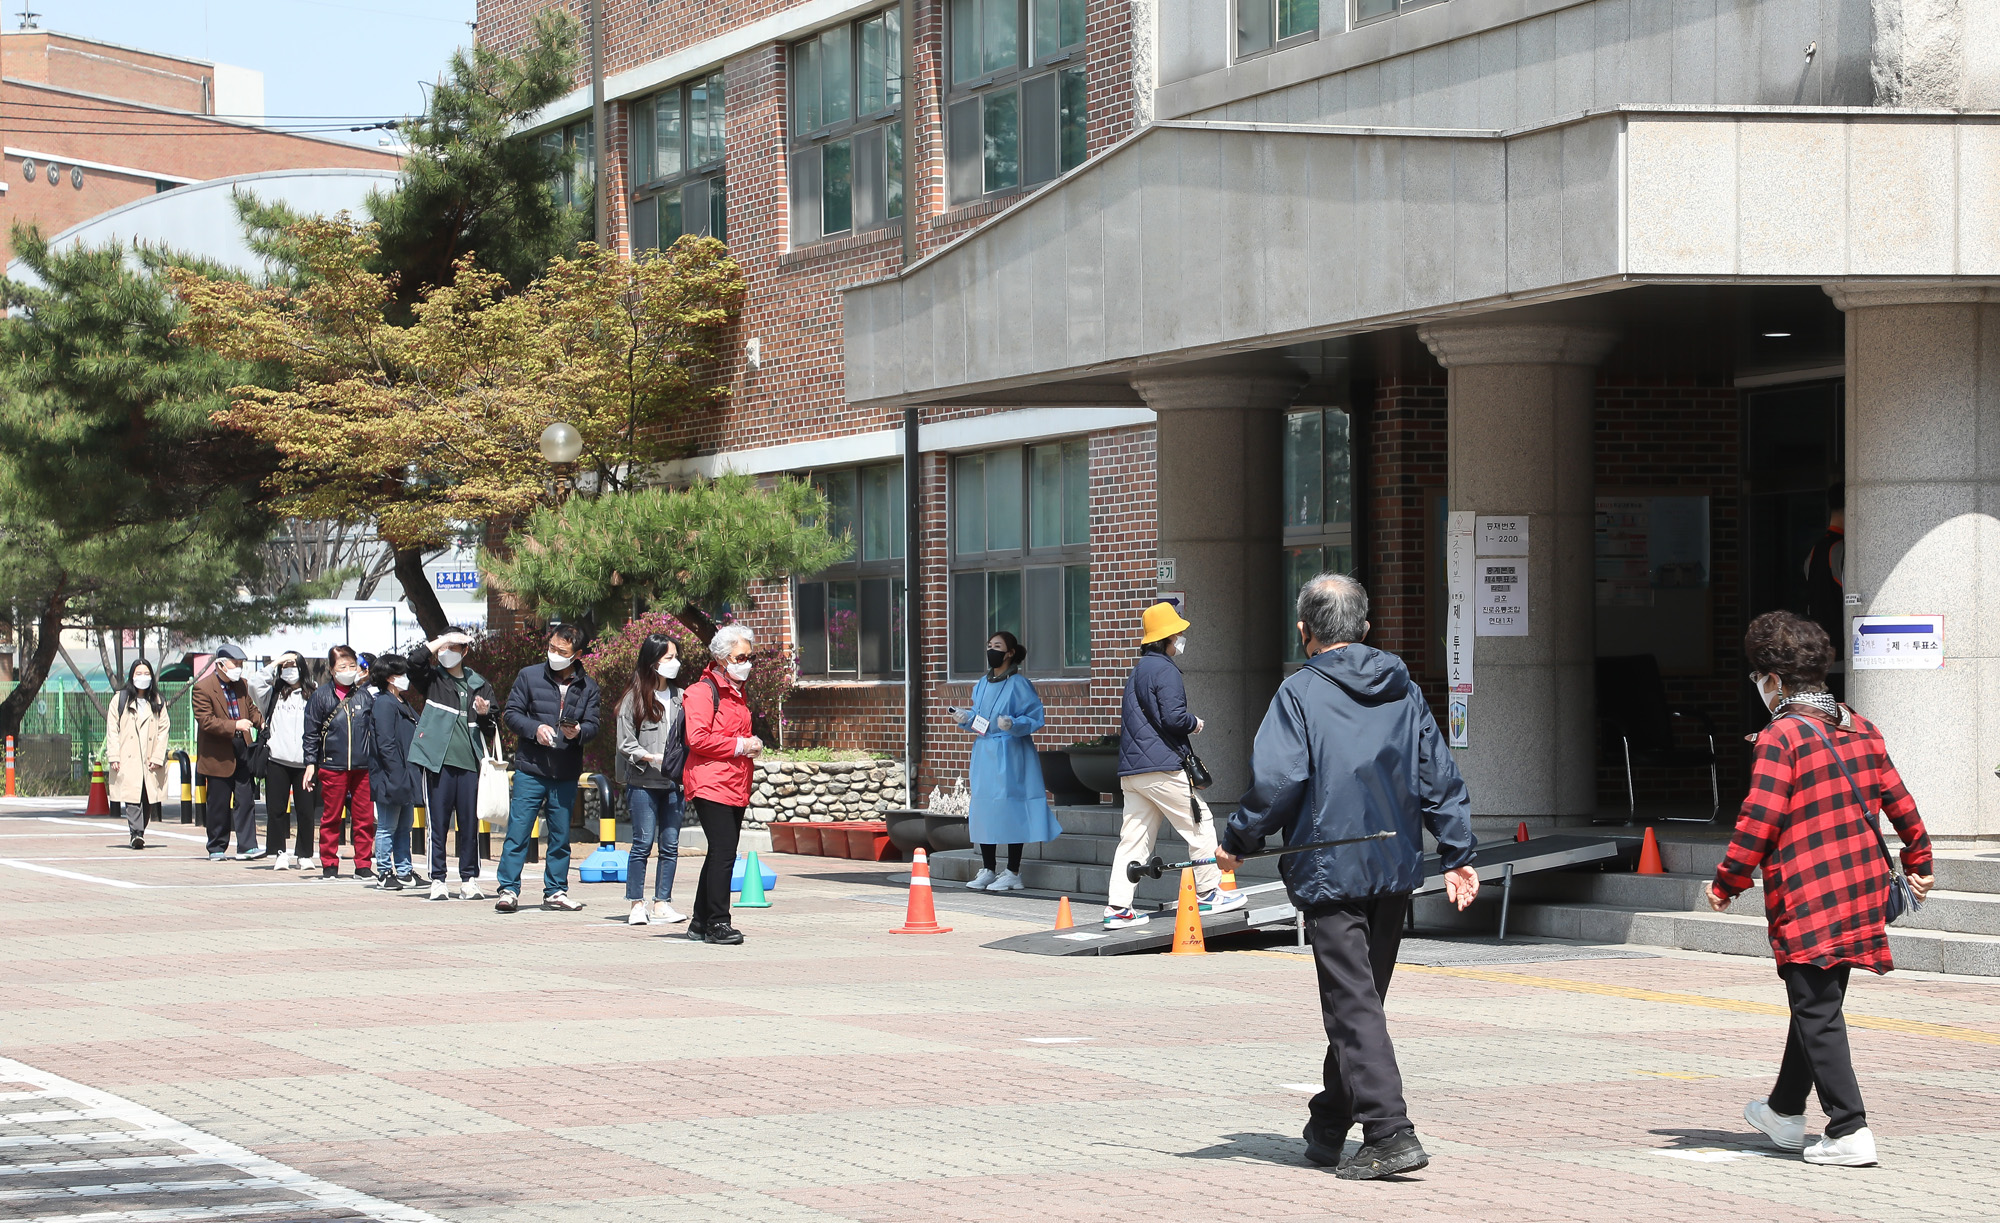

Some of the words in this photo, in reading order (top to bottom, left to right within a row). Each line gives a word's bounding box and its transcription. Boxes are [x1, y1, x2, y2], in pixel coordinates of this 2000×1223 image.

[1487, 522, 1516, 531] 등재번호
[1499, 535, 1518, 543] 2200
[1484, 576, 1518, 584] 제4투표소
[1892, 641, 1899, 650] 제
[1913, 641, 1938, 650] 투표소
